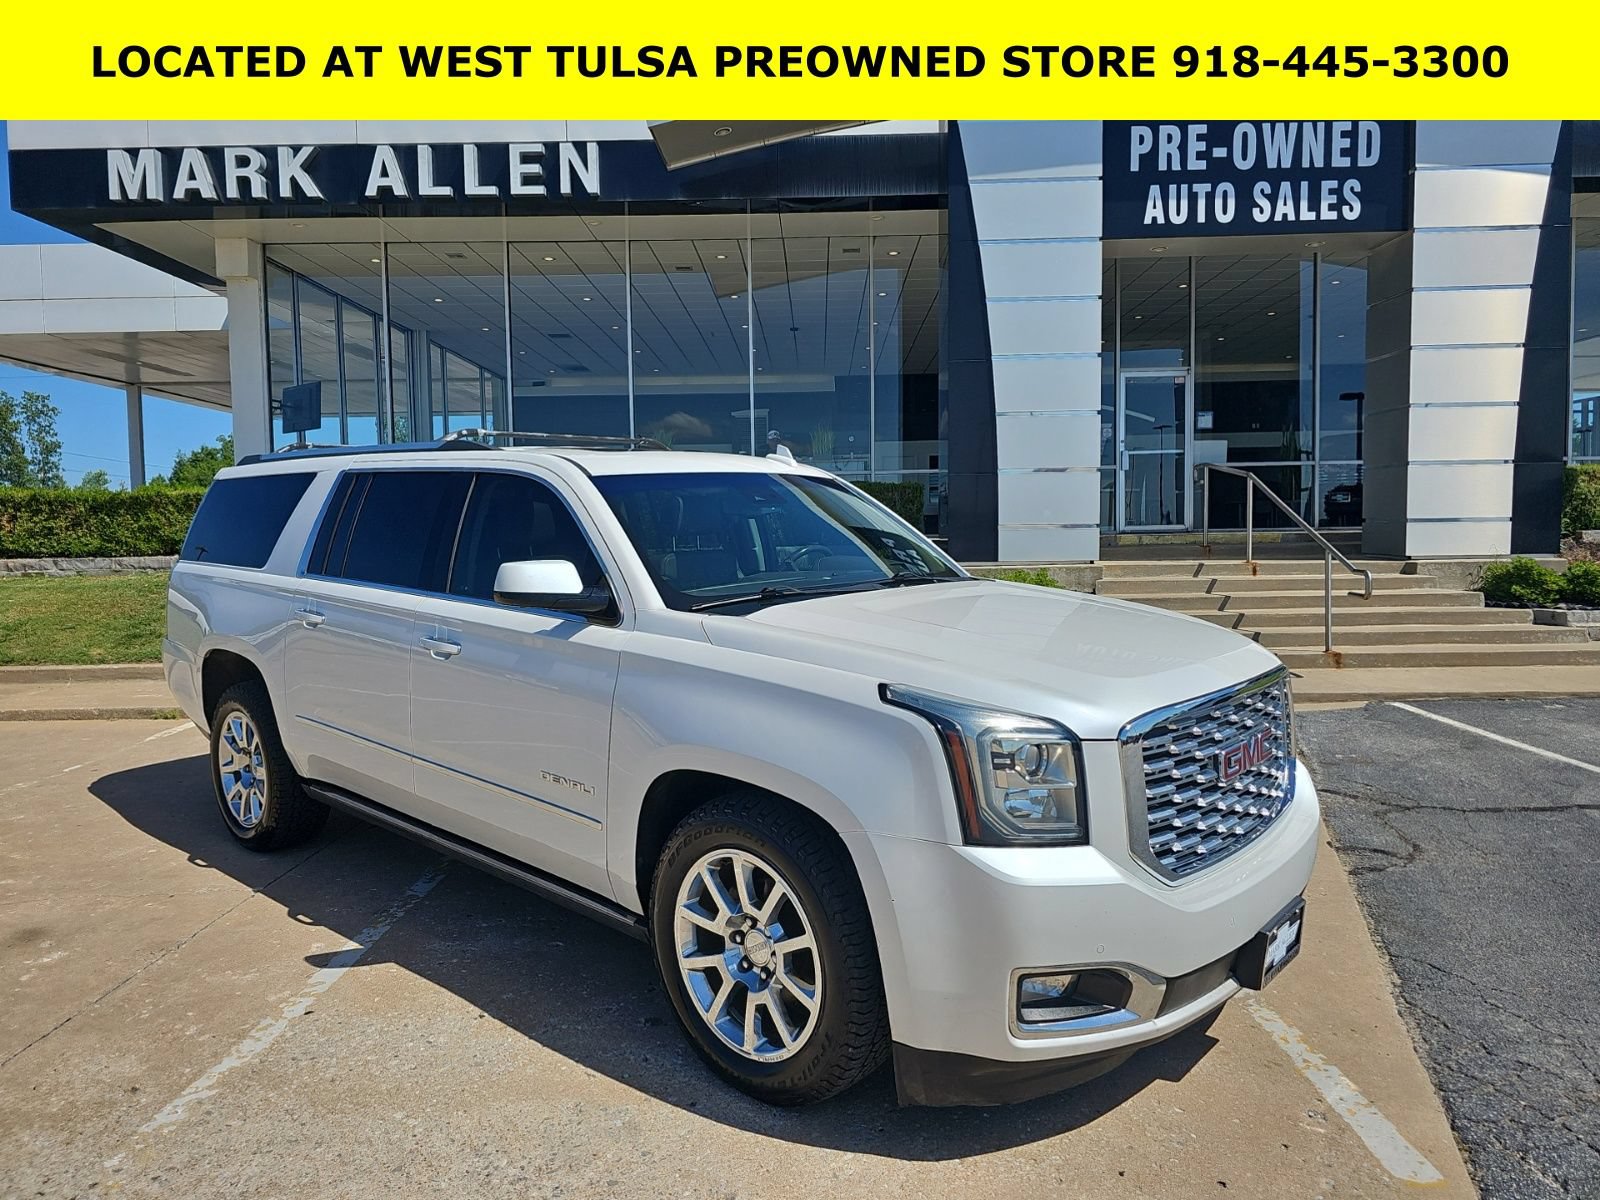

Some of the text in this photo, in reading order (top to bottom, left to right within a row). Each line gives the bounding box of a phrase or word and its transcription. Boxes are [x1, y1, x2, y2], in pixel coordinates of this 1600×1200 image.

[107, 142, 600, 202] MARK ALLEN
[1130, 121, 1381, 172] PRE-OWNED
[1143, 178, 1361, 225] AUTO SALES
[1221, 726, 1273, 781] GMC
[540, 769, 596, 798] DENALI
